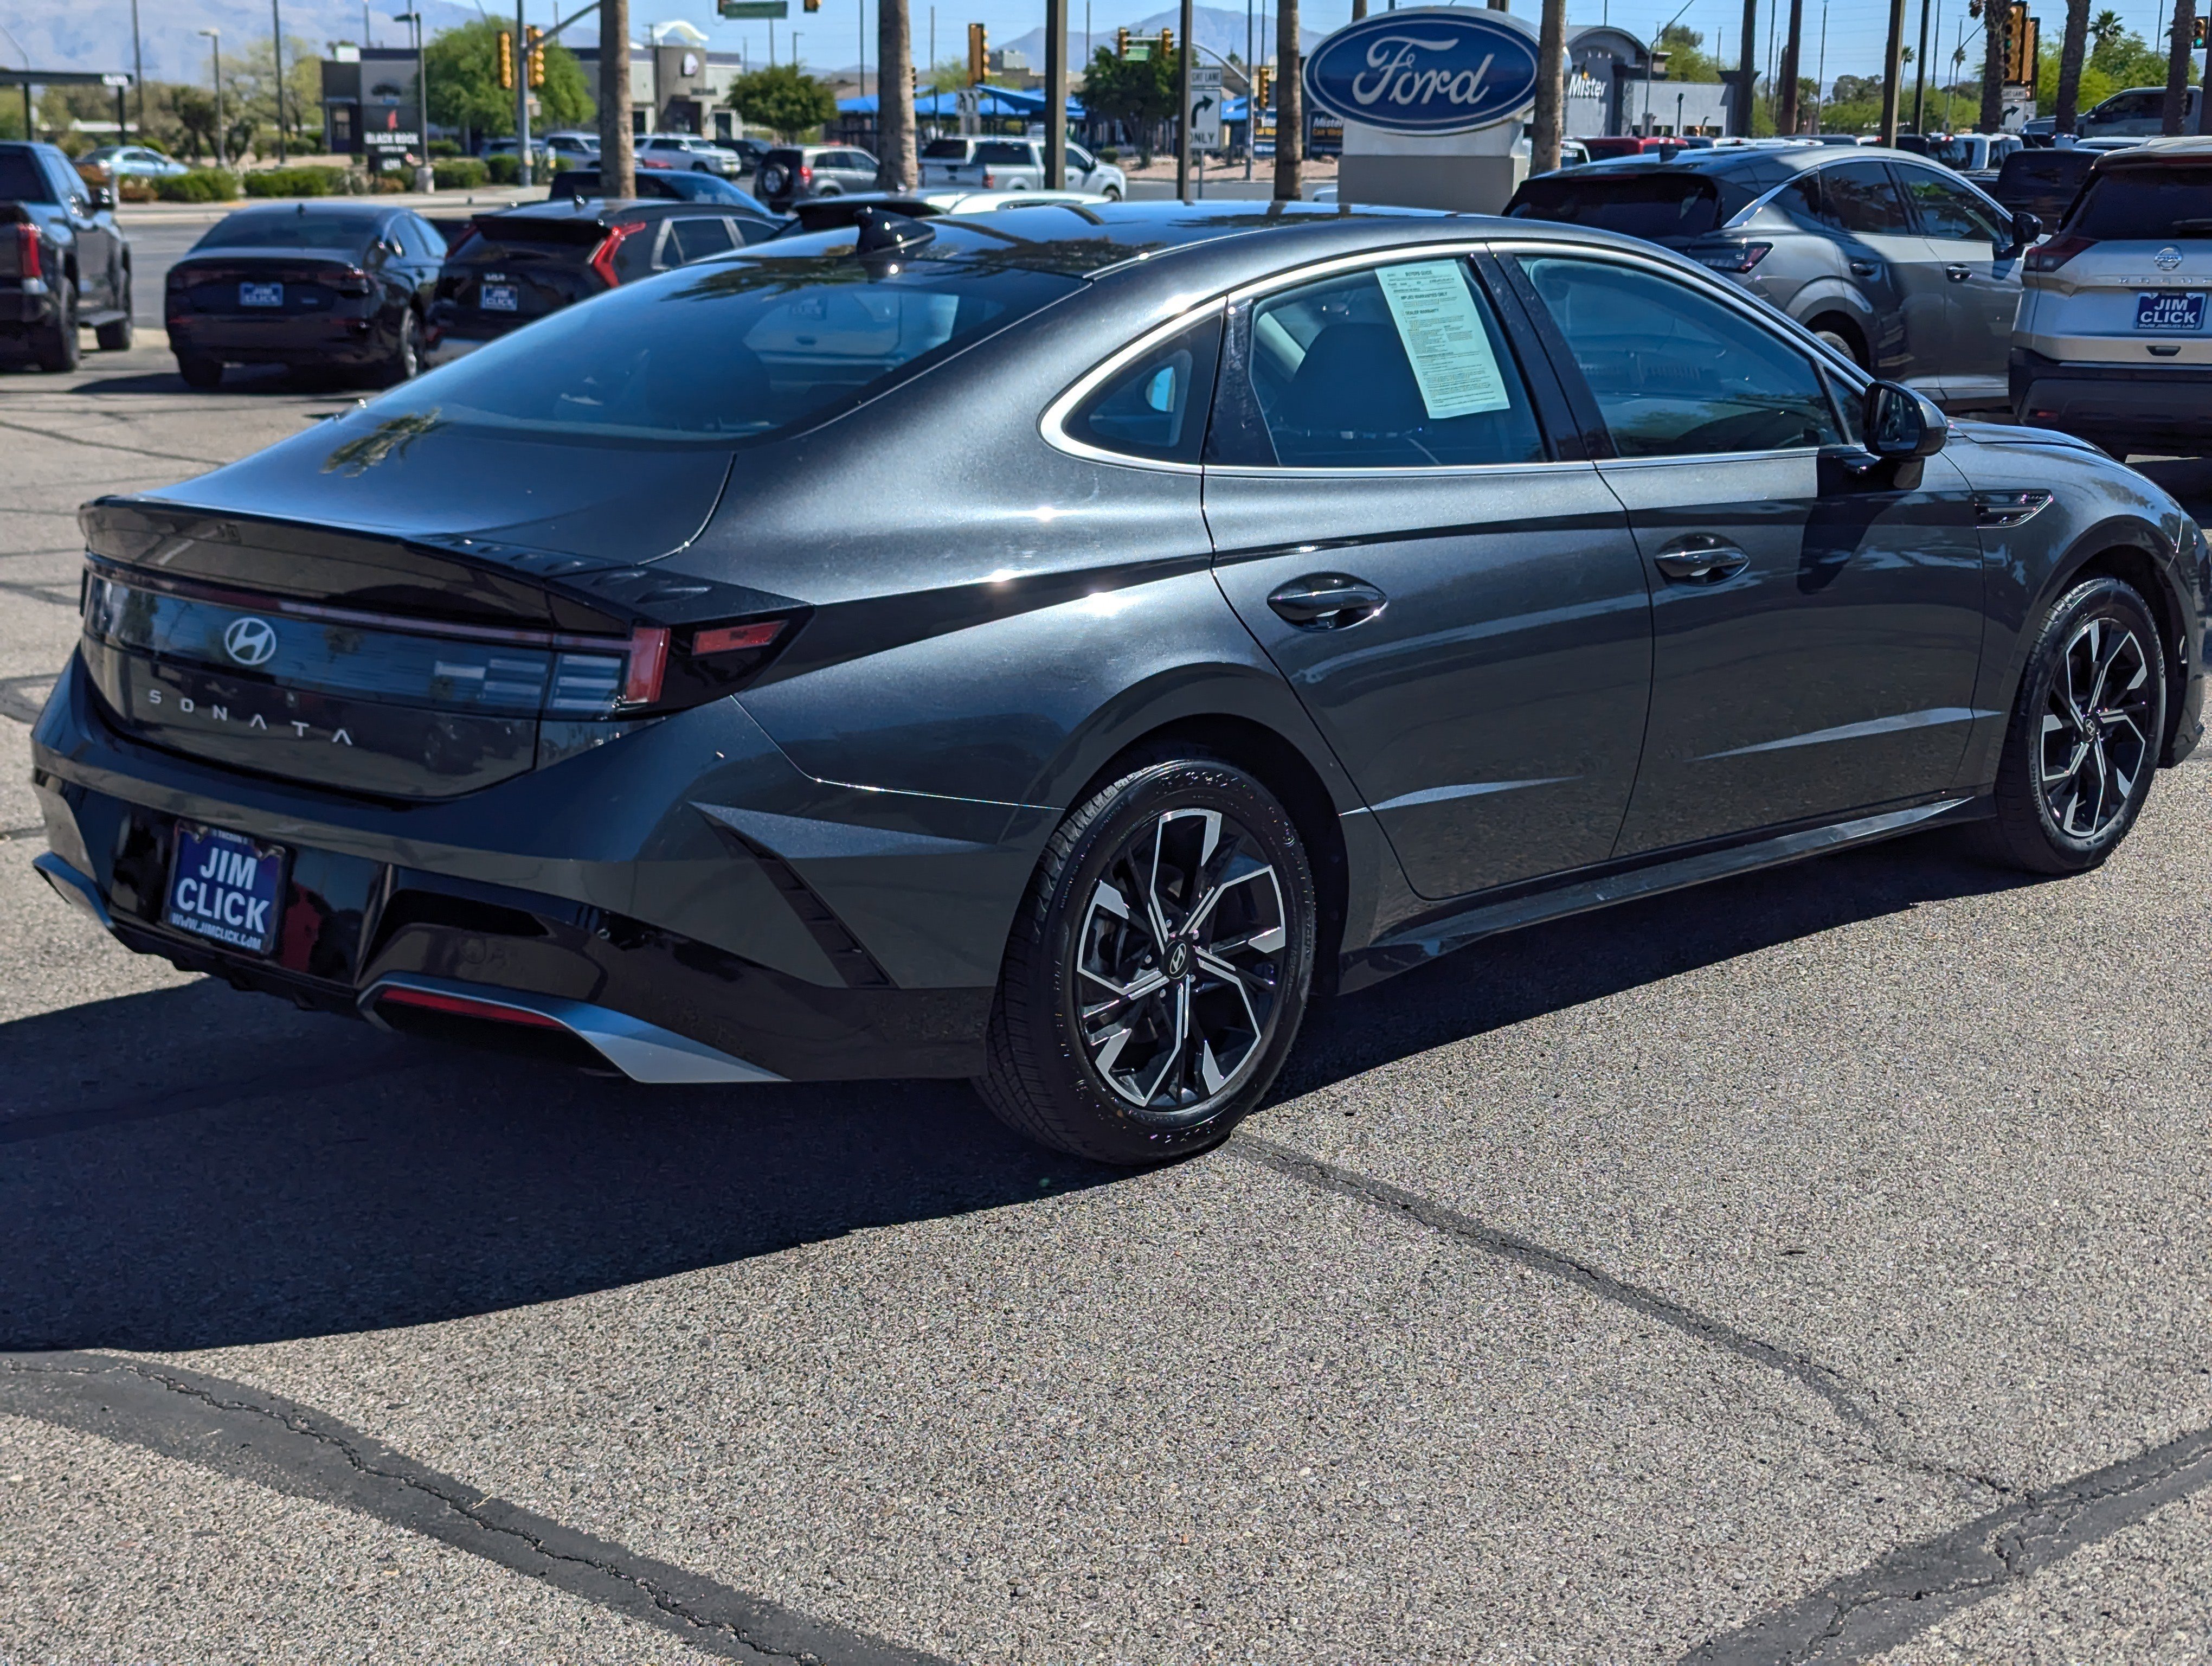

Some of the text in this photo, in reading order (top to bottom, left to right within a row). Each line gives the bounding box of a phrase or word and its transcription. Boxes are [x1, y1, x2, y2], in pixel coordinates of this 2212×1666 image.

[1353, 36, 1495, 105] Ford
[1568, 74, 1607, 97] Mister
[2140, 311, 2197, 323] CLICK
[2153, 299, 2188, 311] JIM
[149, 689, 353, 746] SONATA
[200, 847, 258, 891] JIM
[177, 877, 270, 934] CLICK
